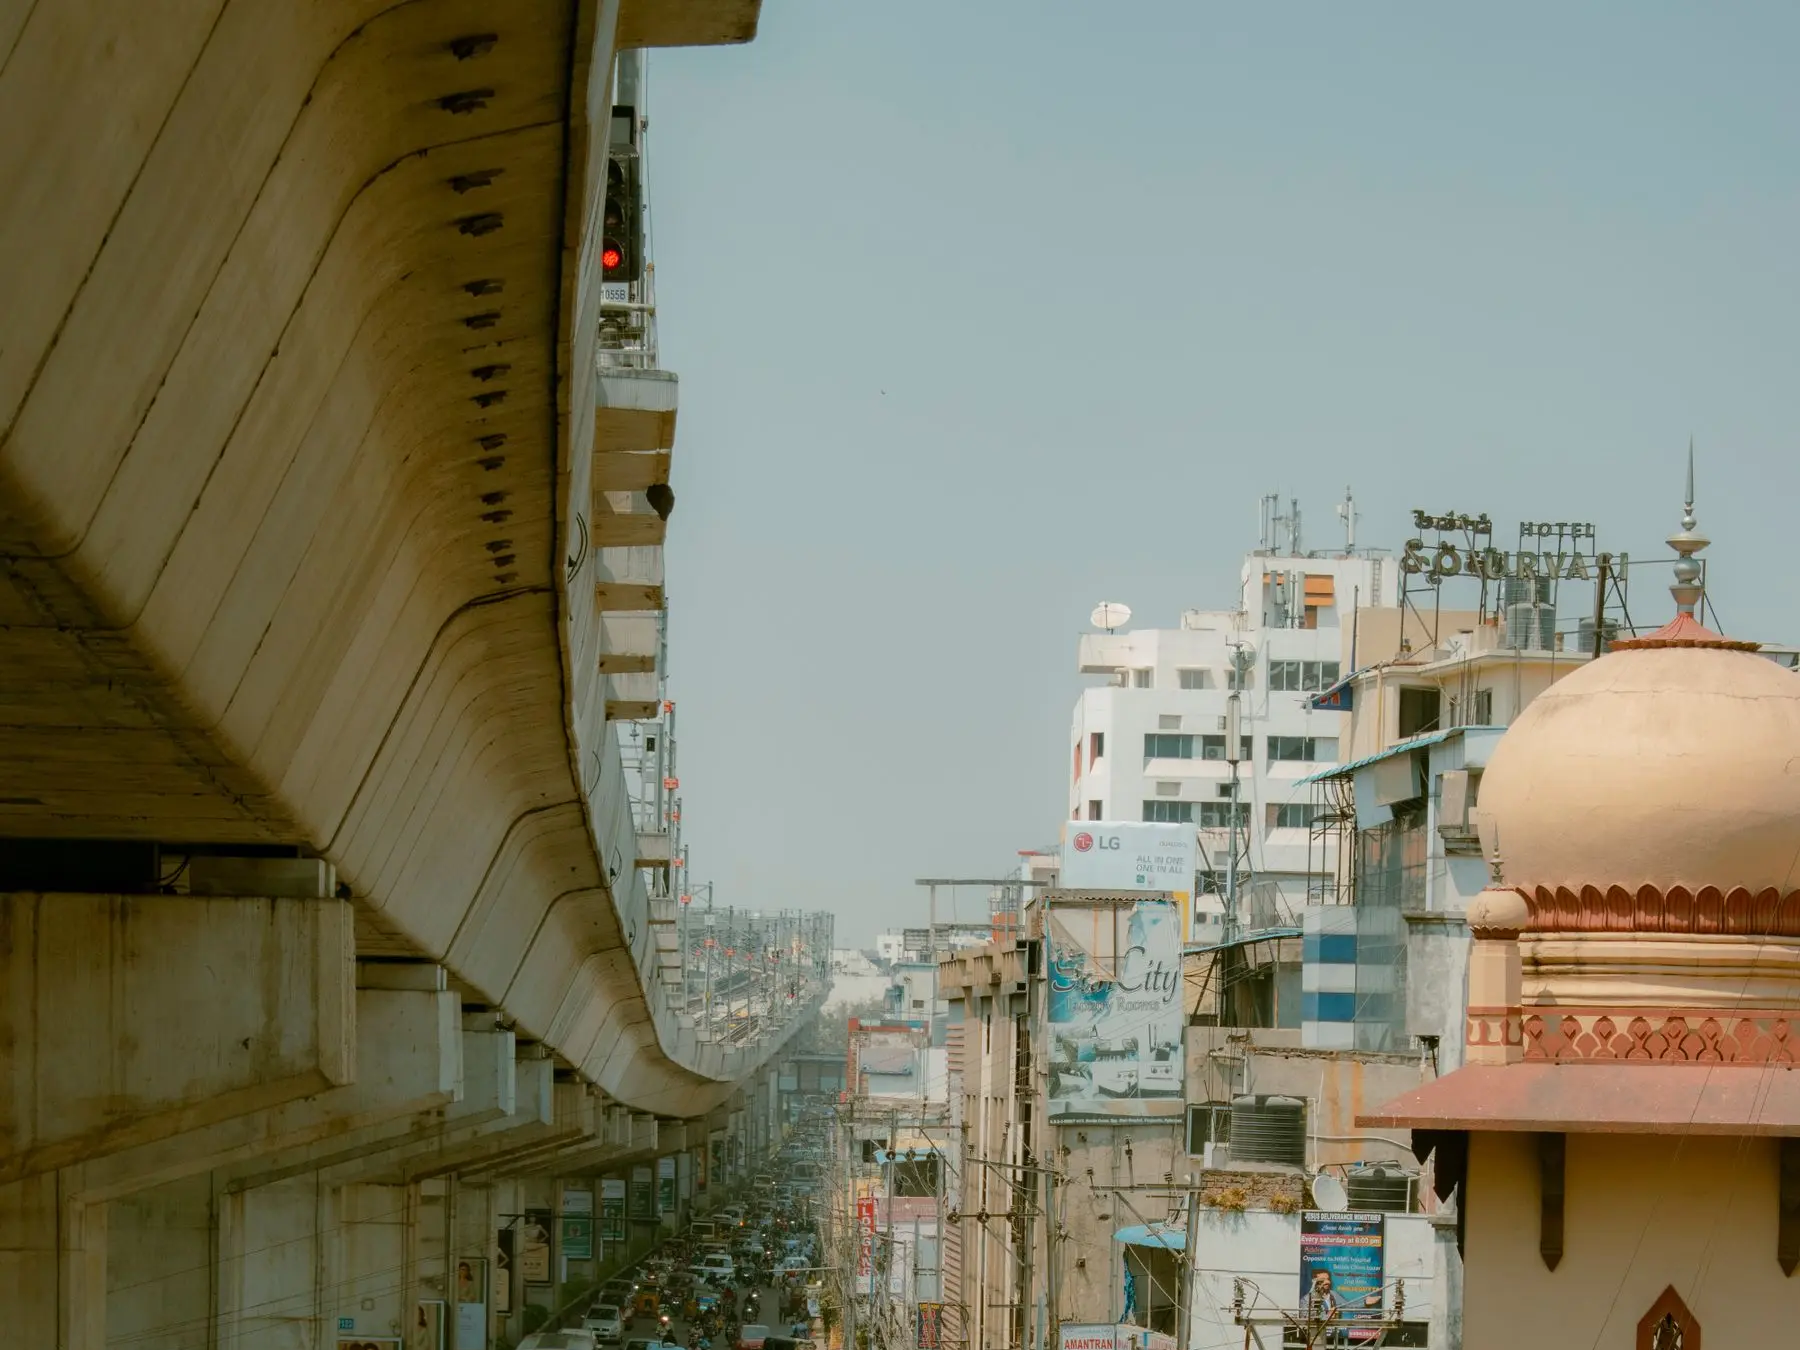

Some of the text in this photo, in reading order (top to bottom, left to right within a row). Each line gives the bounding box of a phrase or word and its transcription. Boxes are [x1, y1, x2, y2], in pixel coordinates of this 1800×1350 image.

[1519, 521, 1596, 538] HOTEL
[1099, 836, 1120, 850] LG
[1136, 855, 1151, 863] ALL
[1166, 856, 1185, 864] ONE
[1136, 864, 1154, 872] ONE
[1157, 865, 1167, 873] IN
[1118, 945, 1179, 1005] City
[1301, 1235, 1318, 1243] Every
[1064, 1339, 1113, 1350] AMANTRAN
